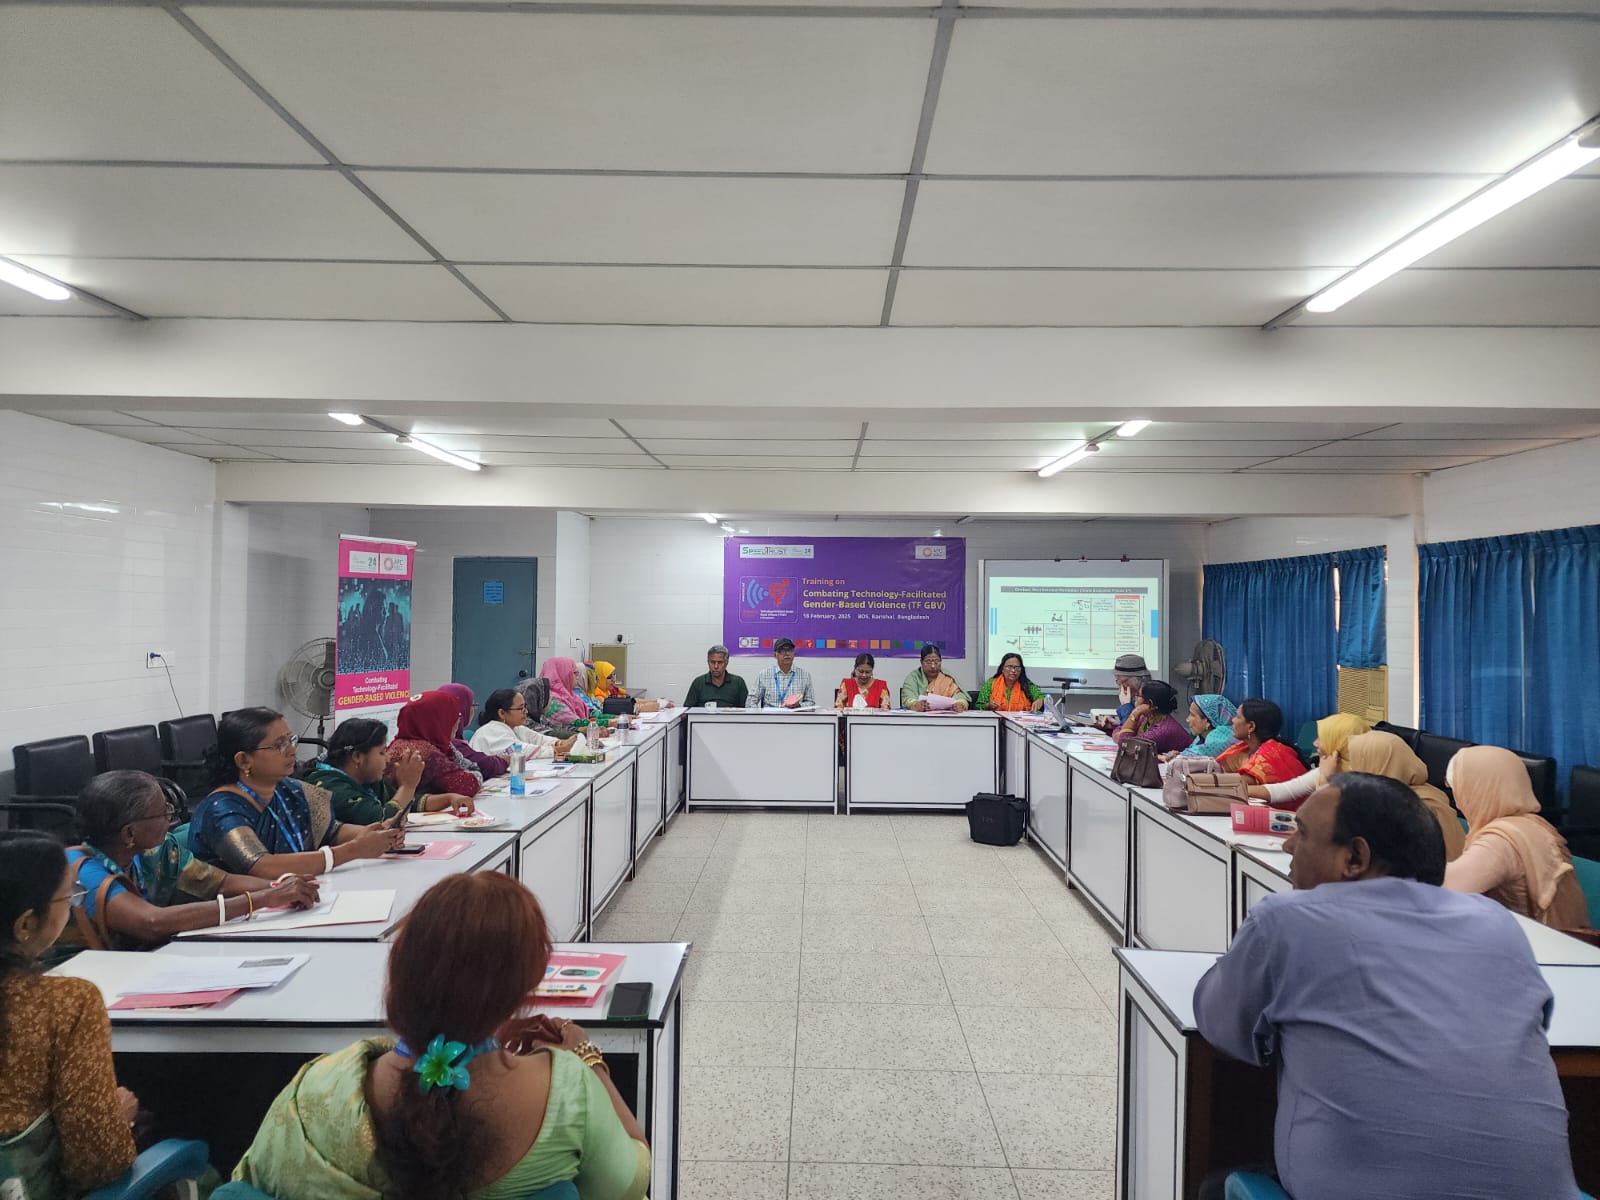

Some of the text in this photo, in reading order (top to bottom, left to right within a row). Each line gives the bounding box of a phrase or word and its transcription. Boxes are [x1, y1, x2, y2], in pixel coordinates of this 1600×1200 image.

[802, 578, 834, 587] Training
[803, 590, 947, 600] Combating Technology-Facilitated
[803, 600, 946, 611] Gender-Based Violence (TF GBV)
[365, 676, 388, 684] Combating
[338, 690, 410, 706] GENDER-BASED VIOLENC
